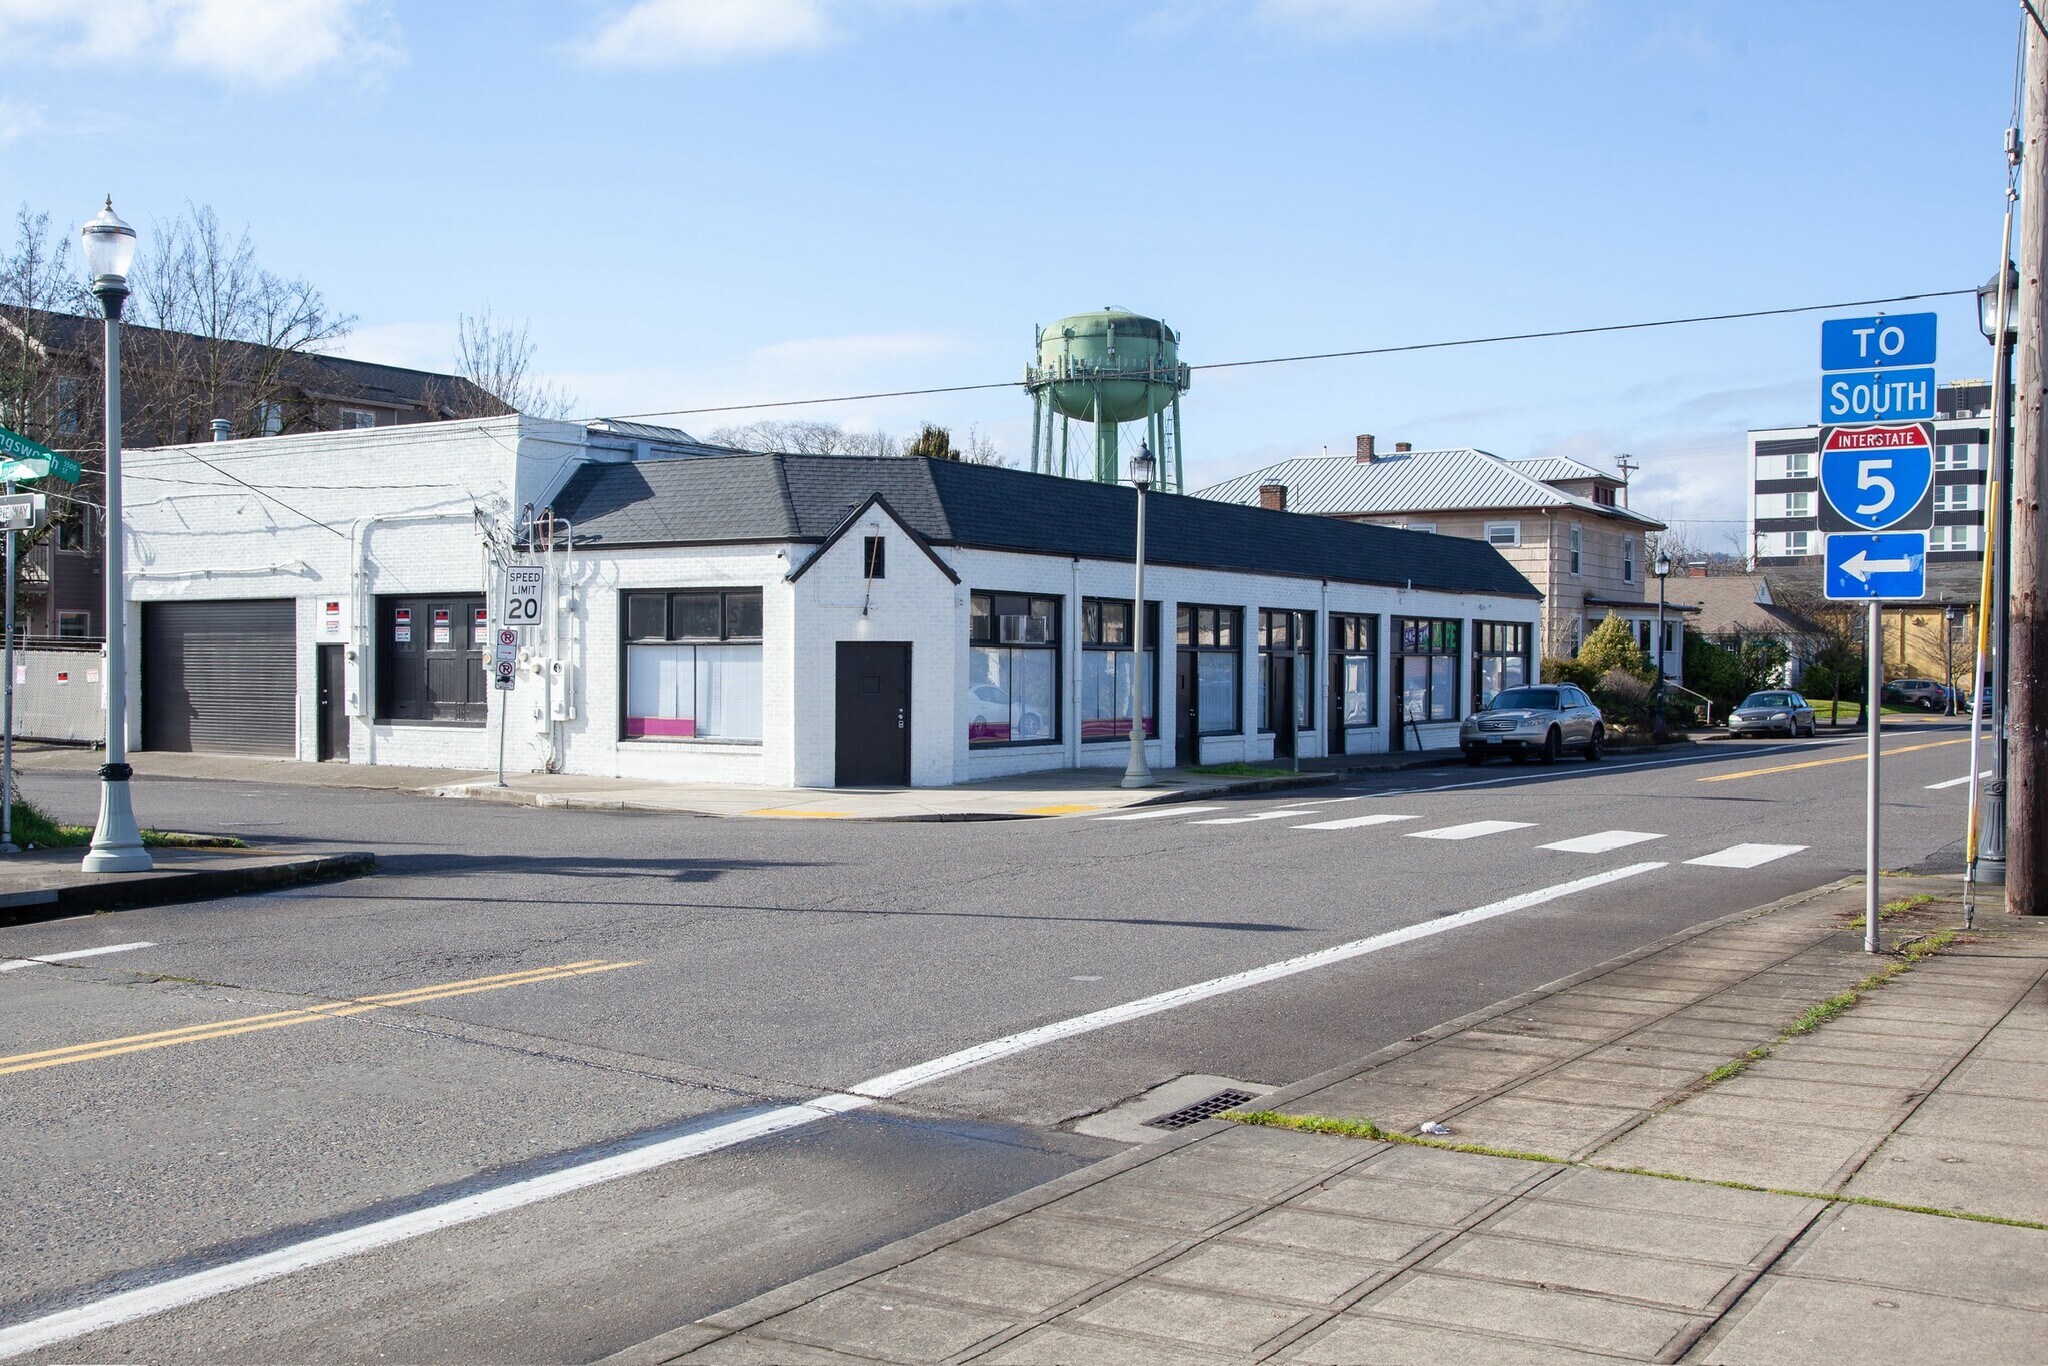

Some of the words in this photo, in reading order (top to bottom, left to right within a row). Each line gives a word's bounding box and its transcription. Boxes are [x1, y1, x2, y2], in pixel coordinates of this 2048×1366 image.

[1852, 326, 1905, 357] TO
[1829, 381, 1926, 415] SOUTH
[1838, 431, 1914, 447] INTERSTATE
[1856, 459, 1895, 515] 5
[510, 573, 540, 582] SPEED
[512, 586, 536, 595] LIMIT
[508, 598, 537, 618] 20
